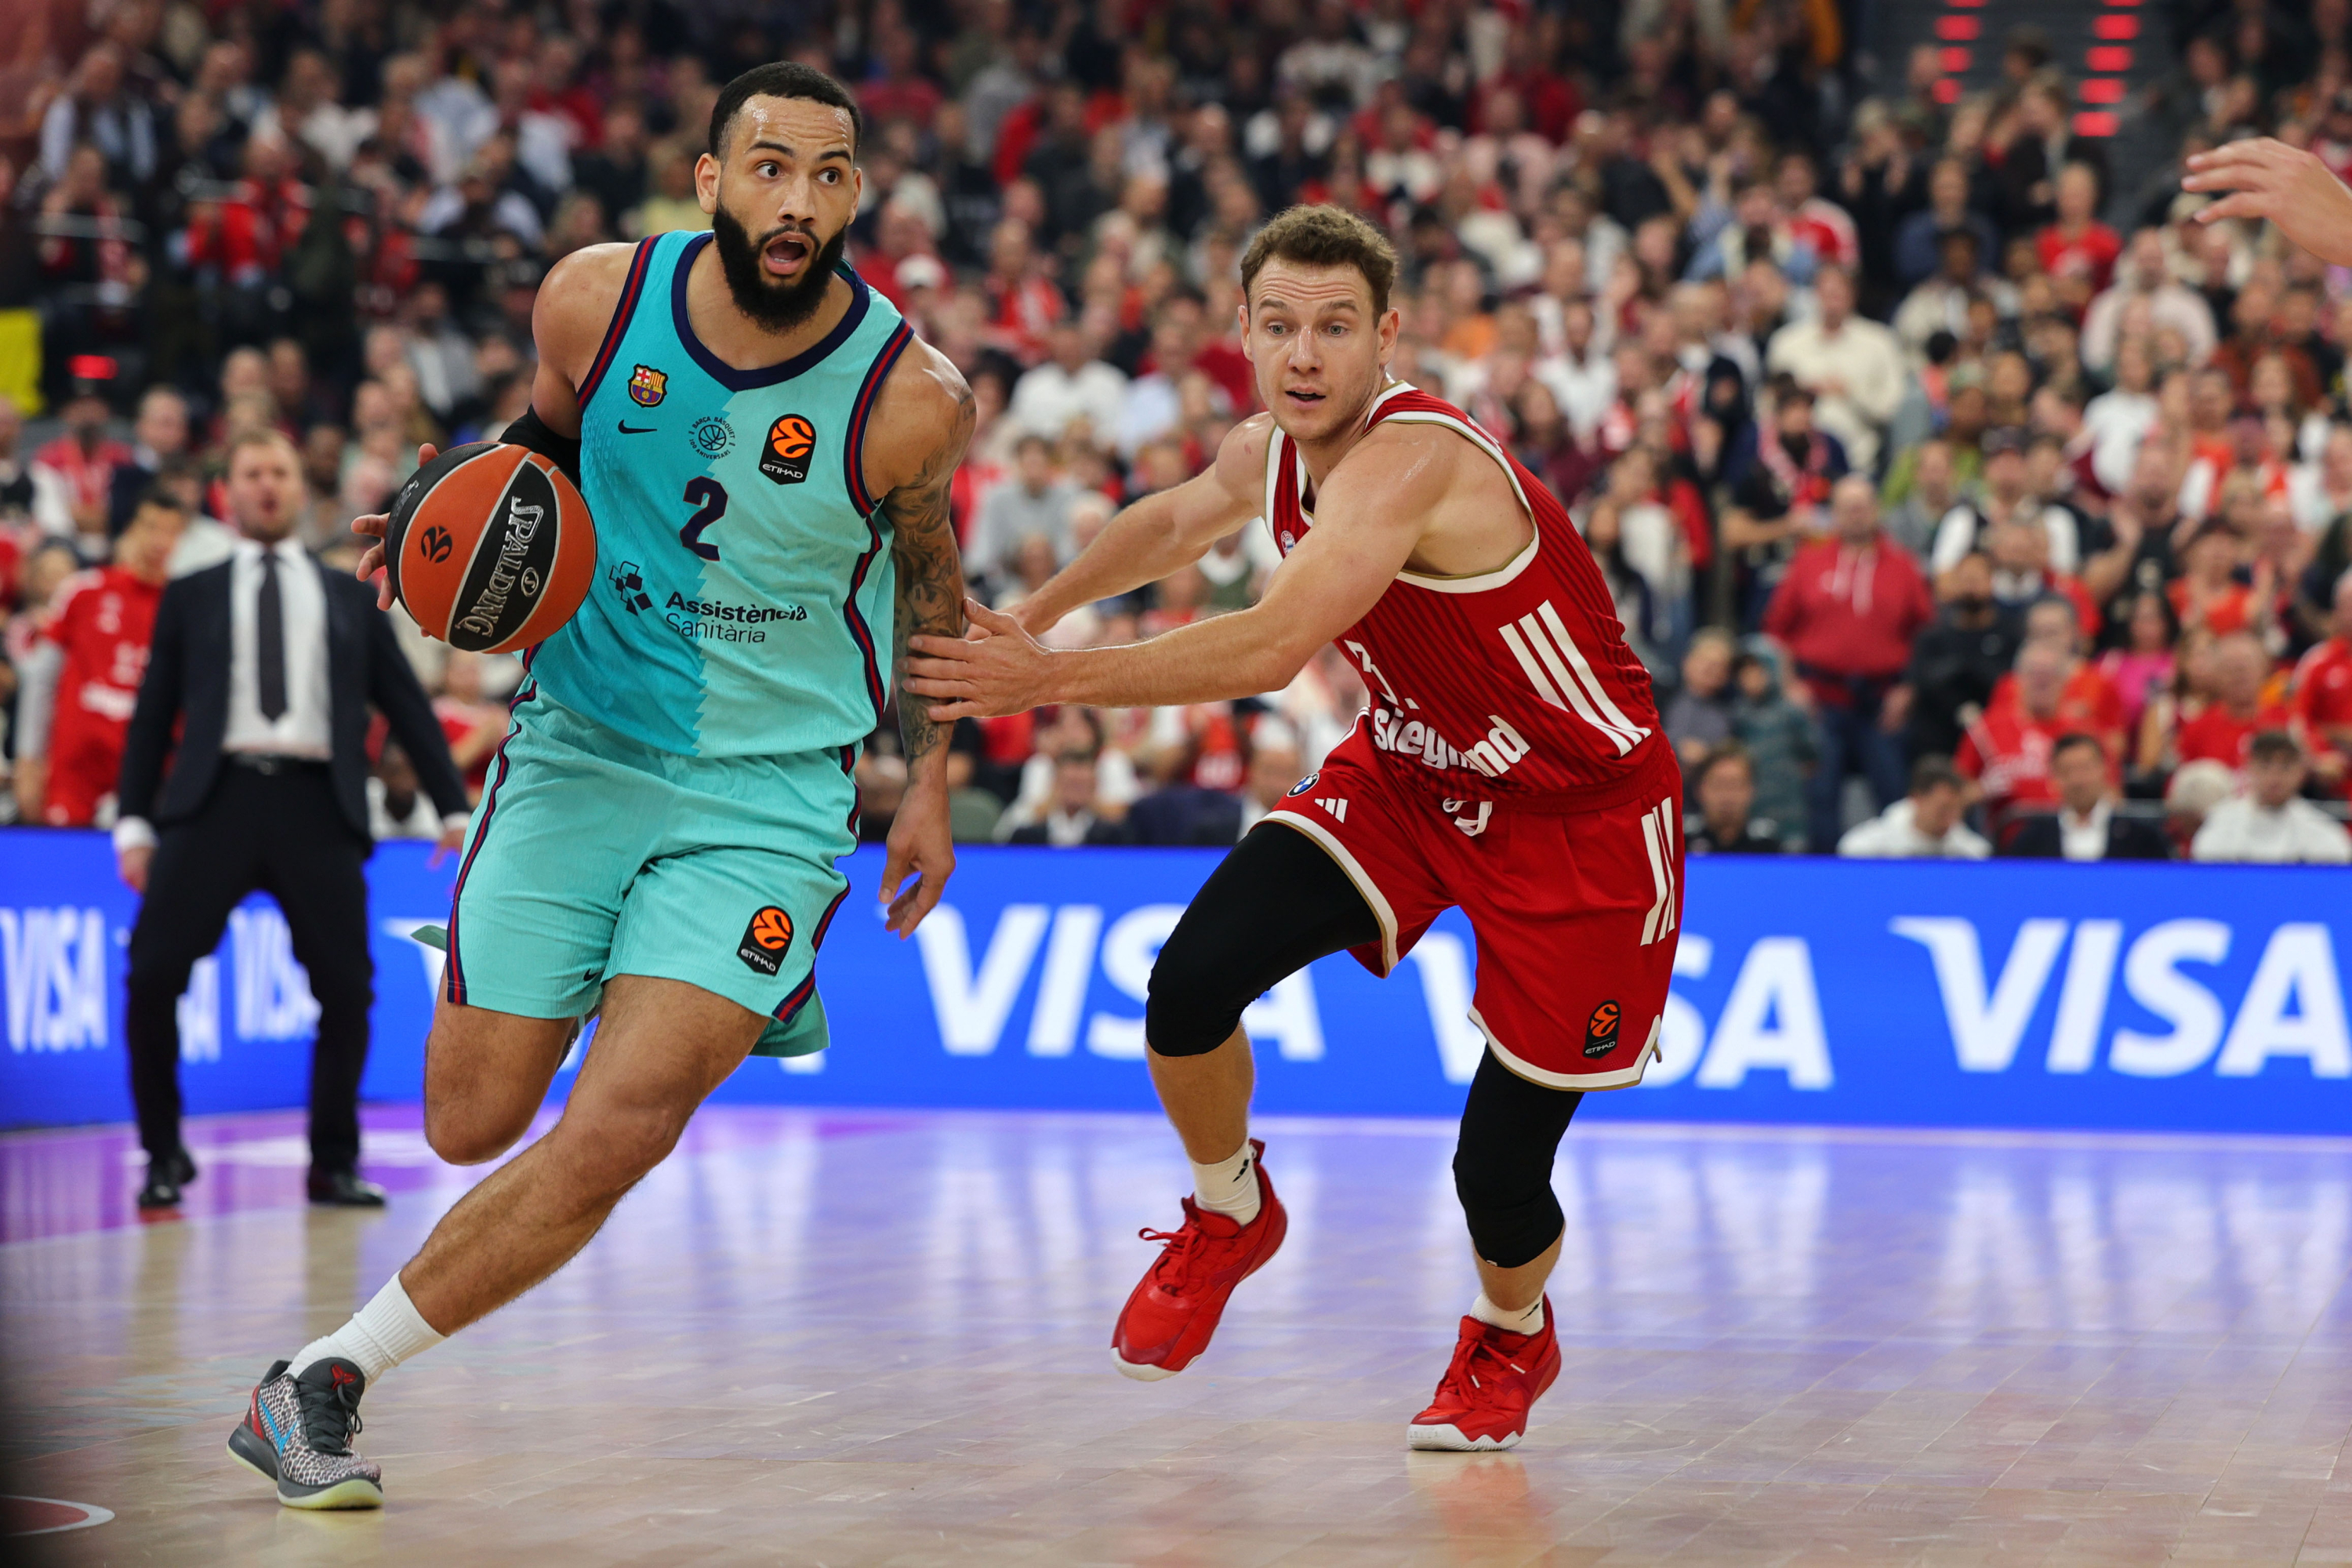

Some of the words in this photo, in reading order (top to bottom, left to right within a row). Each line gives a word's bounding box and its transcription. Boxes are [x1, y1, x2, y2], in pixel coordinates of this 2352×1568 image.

[695, 449, 731, 459] ANIVERSARI
[762, 463, 804, 479] ETIHAD
[679, 475, 728, 561] 2
[454, 495, 544, 637] SPALDING
[665, 591, 808, 624] Assistència
[666, 612, 766, 644] Sanitària
[741, 948, 776, 972] ETIHAD
[1888, 916, 2352, 1079] VISA
[1584, 1041, 1616, 1054] ETIHAD
